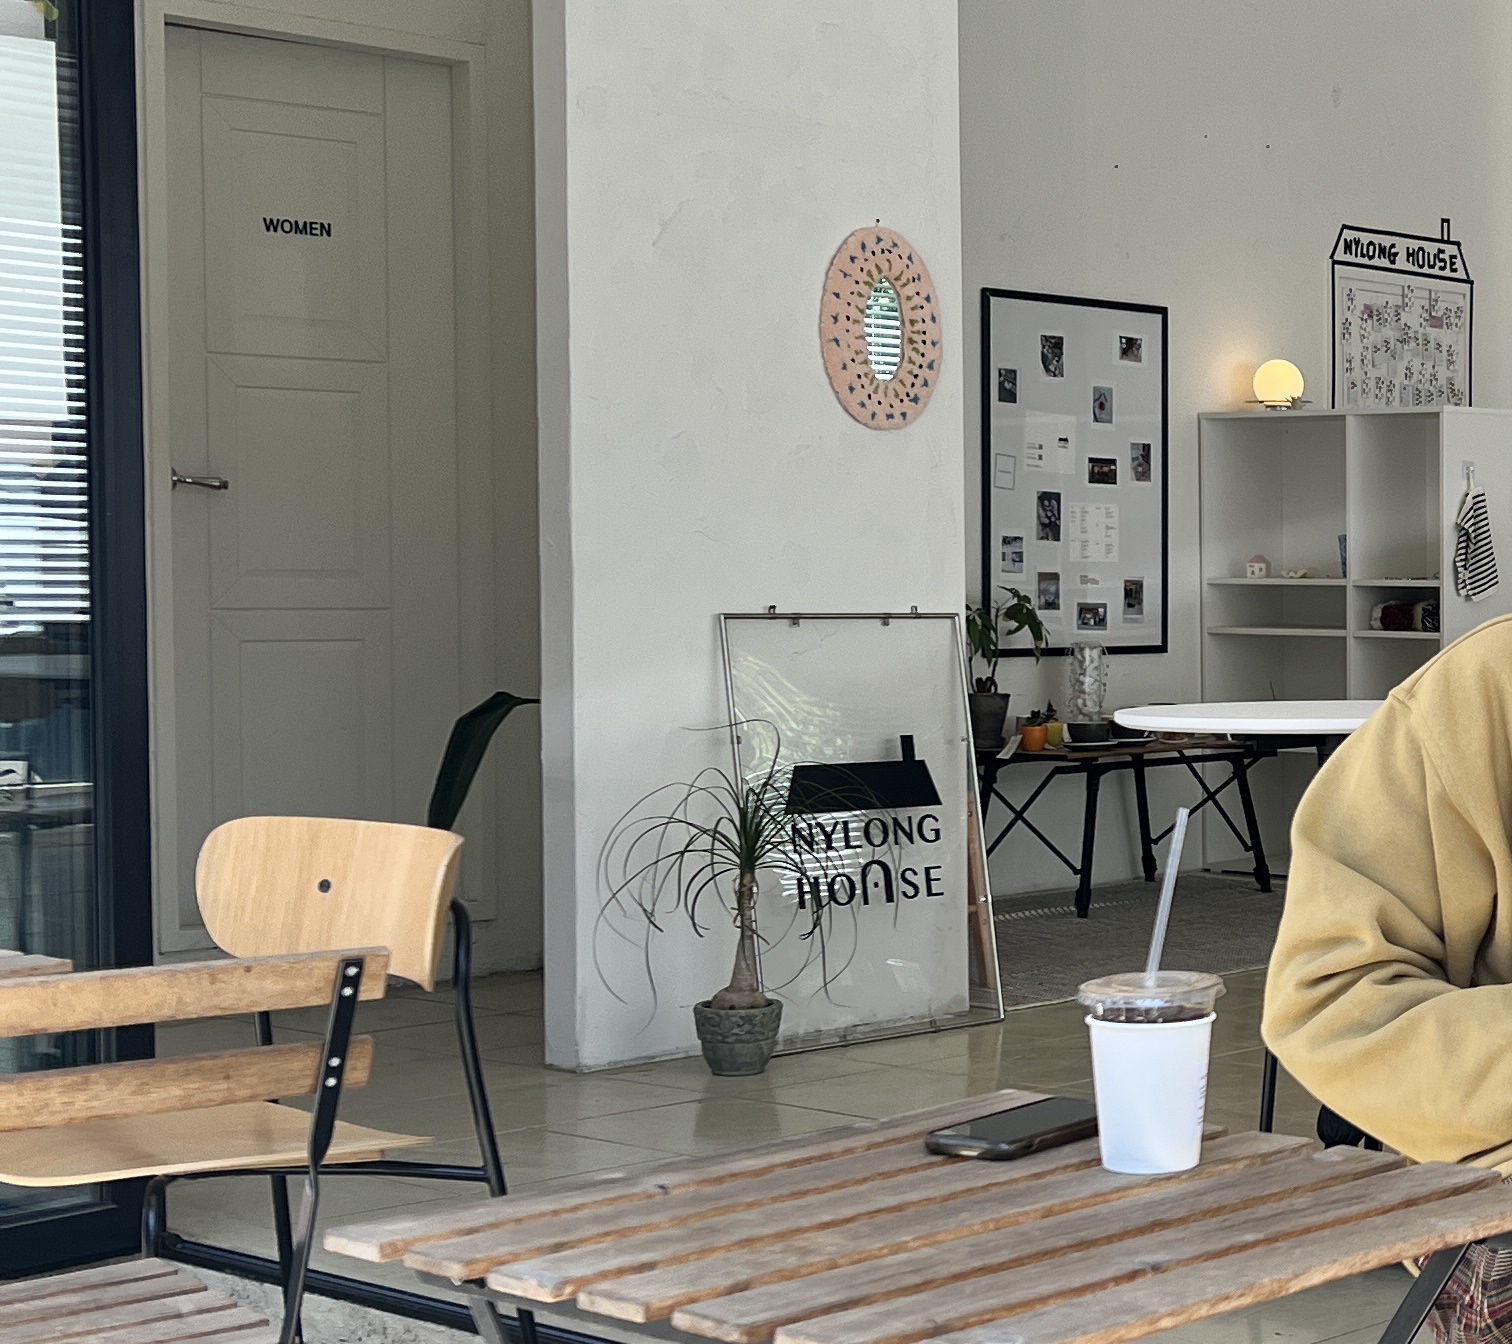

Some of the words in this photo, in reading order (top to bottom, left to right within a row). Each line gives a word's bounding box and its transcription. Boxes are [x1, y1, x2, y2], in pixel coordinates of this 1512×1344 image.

[262, 217, 332, 238] WOMEN
[1343, 236, 1400, 265] NYLONG
[1405, 246, 1458, 273] HOUSE
[791, 813, 942, 854] NYLONG
